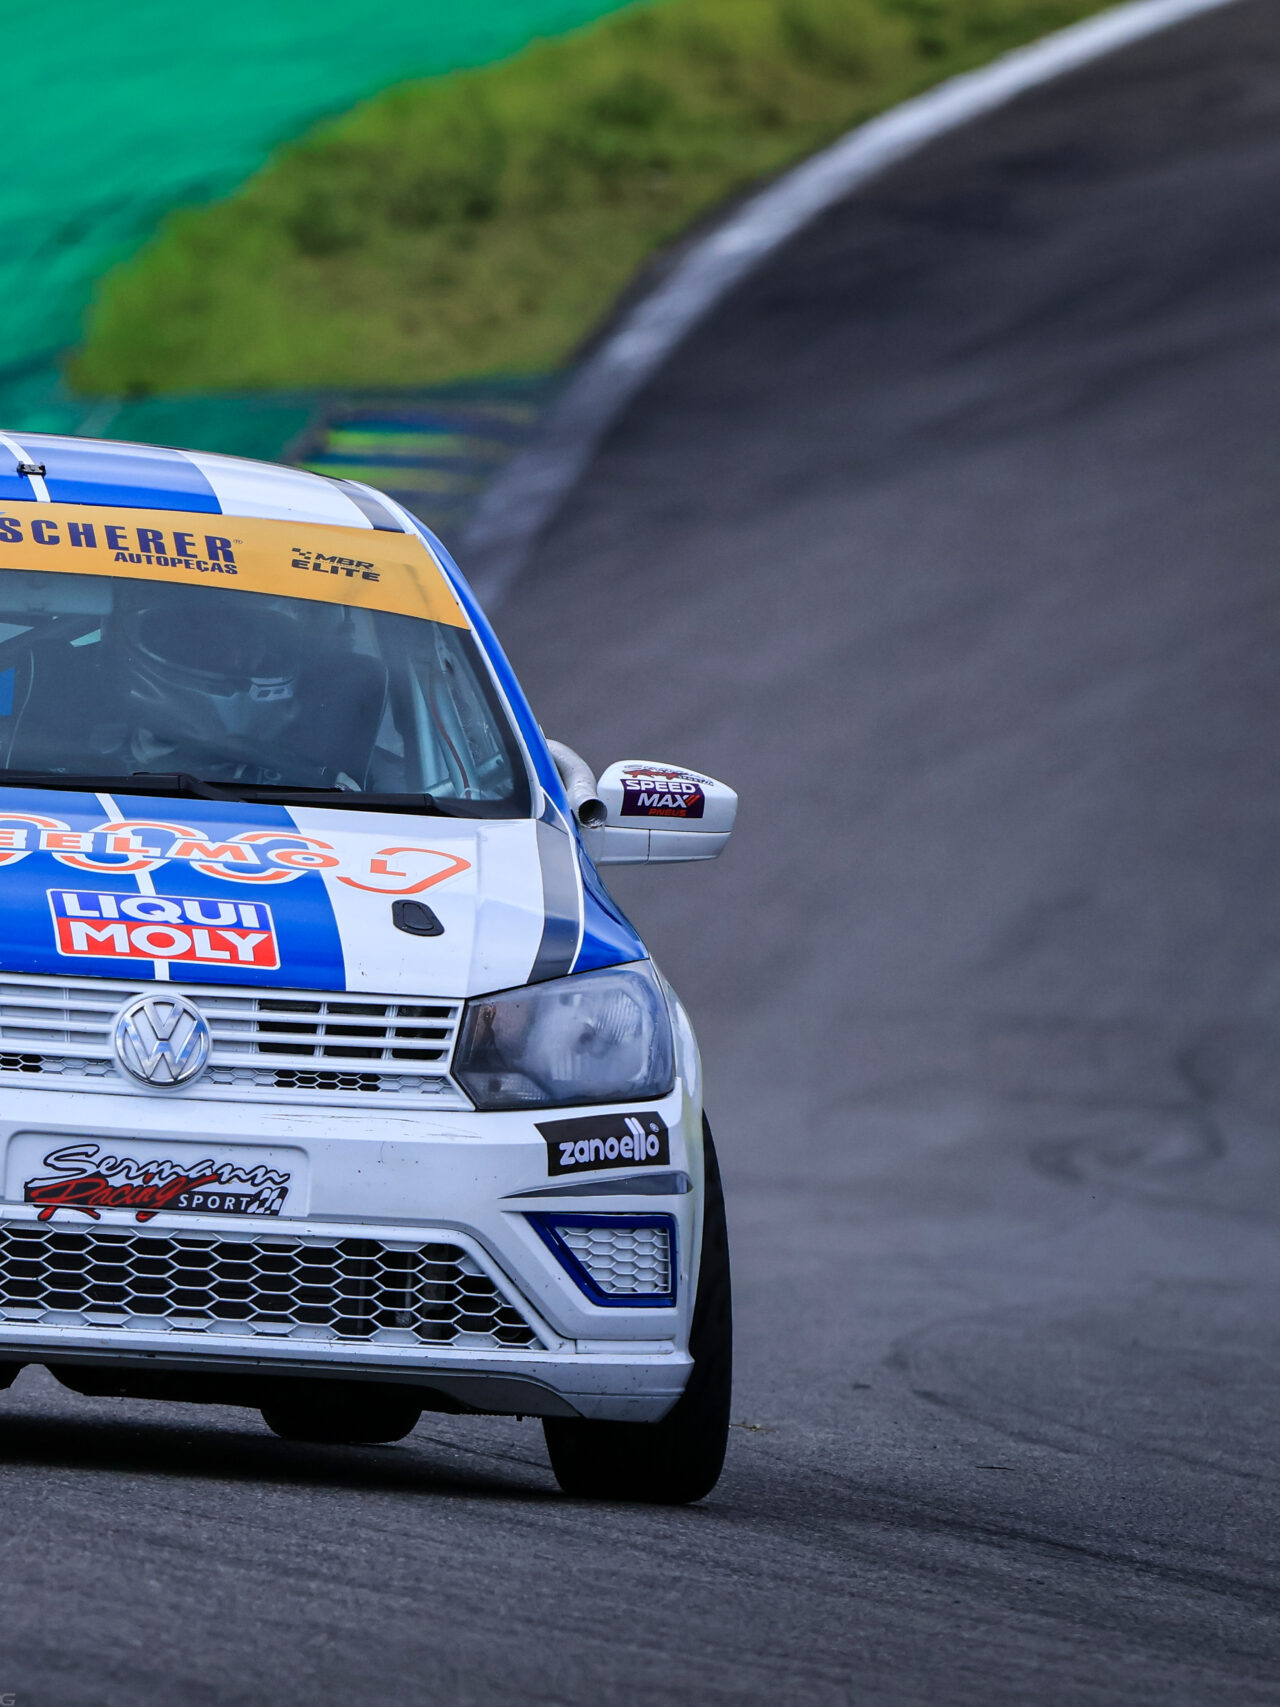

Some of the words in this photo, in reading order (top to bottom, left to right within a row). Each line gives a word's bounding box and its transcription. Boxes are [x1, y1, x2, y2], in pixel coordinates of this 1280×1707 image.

[114, 551, 239, 575] AUTOPEÇAS
[315, 553, 375, 569] MBR
[292, 559, 381, 582] ELITE
[625, 780, 697, 794] SPEED
[637, 793, 689, 808] MAX
[648, 808, 687, 817] PNEUS
[61, 893, 261, 929] LIQUI
[69, 921, 270, 962] MOLY
[177, 1193, 248, 1211] SPORT
